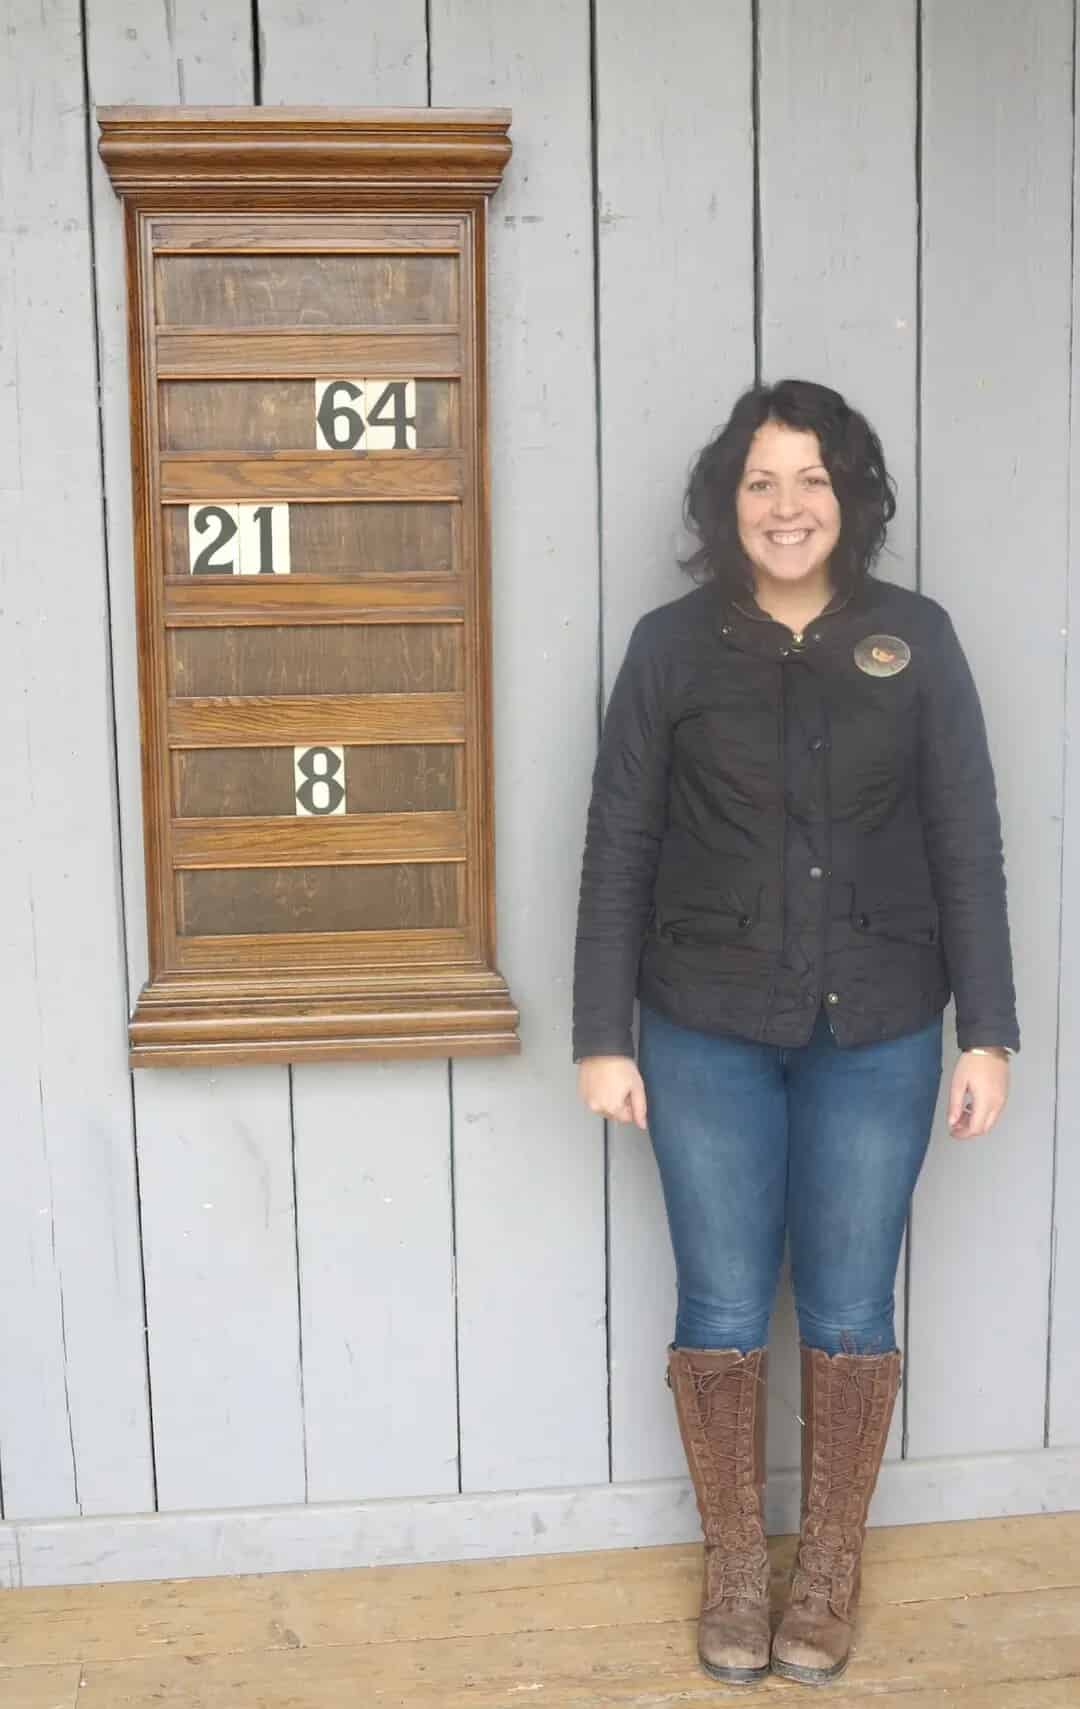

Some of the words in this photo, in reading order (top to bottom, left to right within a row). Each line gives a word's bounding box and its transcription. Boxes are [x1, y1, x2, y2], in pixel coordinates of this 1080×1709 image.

[317, 381, 416, 449] 64
[192, 506, 275, 575] 21
[296, 746, 345, 815] 8
